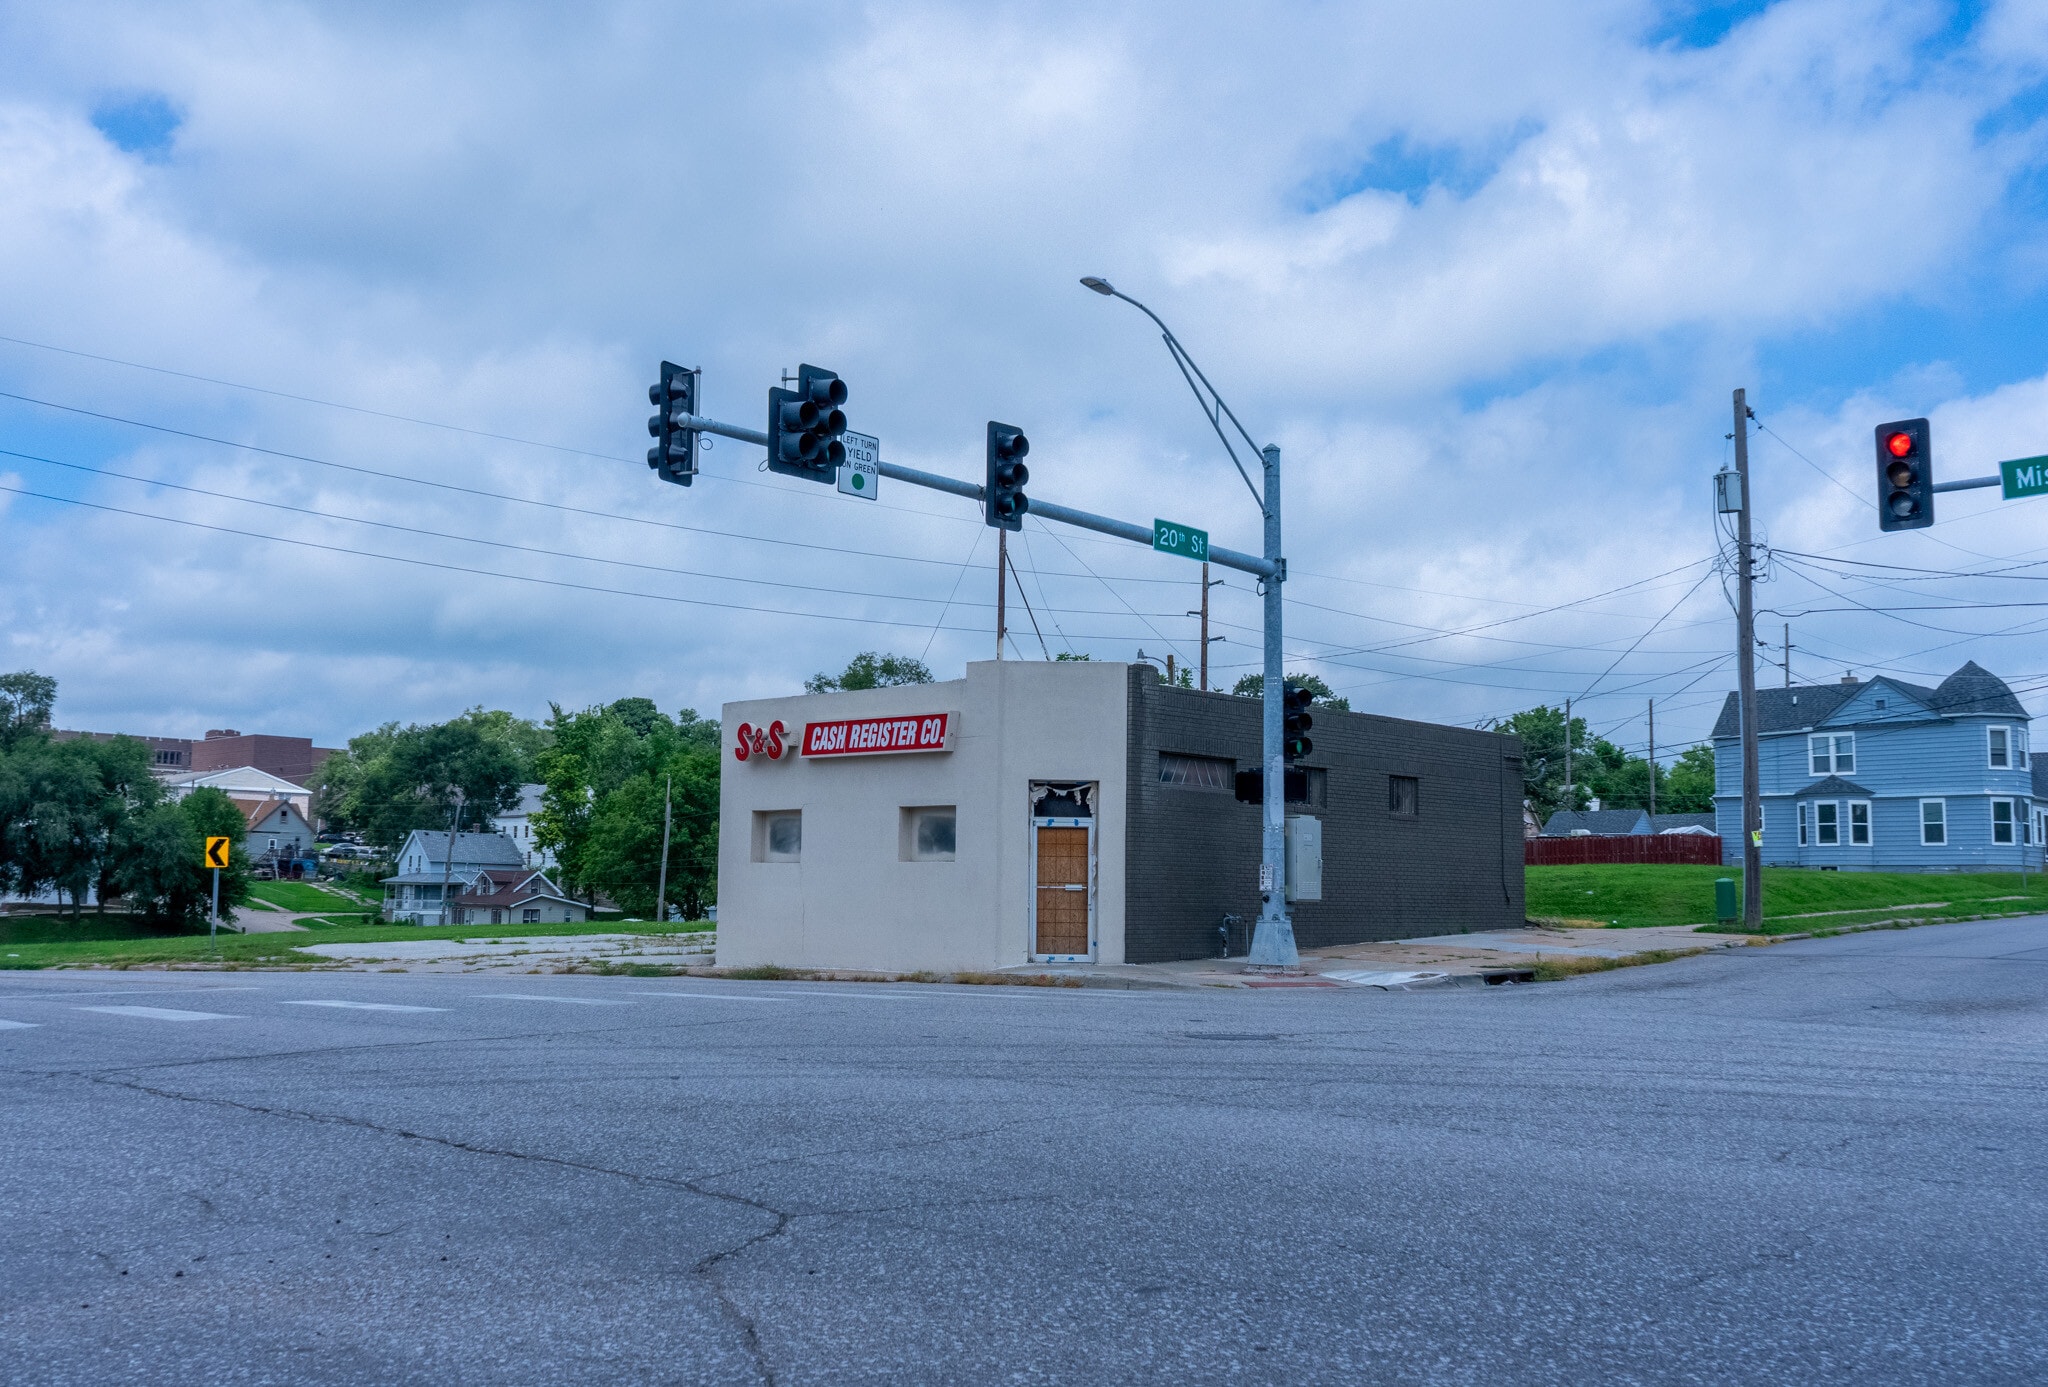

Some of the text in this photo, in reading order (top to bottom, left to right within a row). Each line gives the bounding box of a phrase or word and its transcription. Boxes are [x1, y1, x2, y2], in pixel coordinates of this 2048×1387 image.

[843, 435, 877, 451] LEFT TURN
[847, 447, 872, 462] YIELD
[854, 462, 876, 474] GREEN
[1159, 527, 1203, 554] 20th St
[735, 720, 784, 761] S&S
[811, 718, 944, 751] CASH REGISTER CO.
